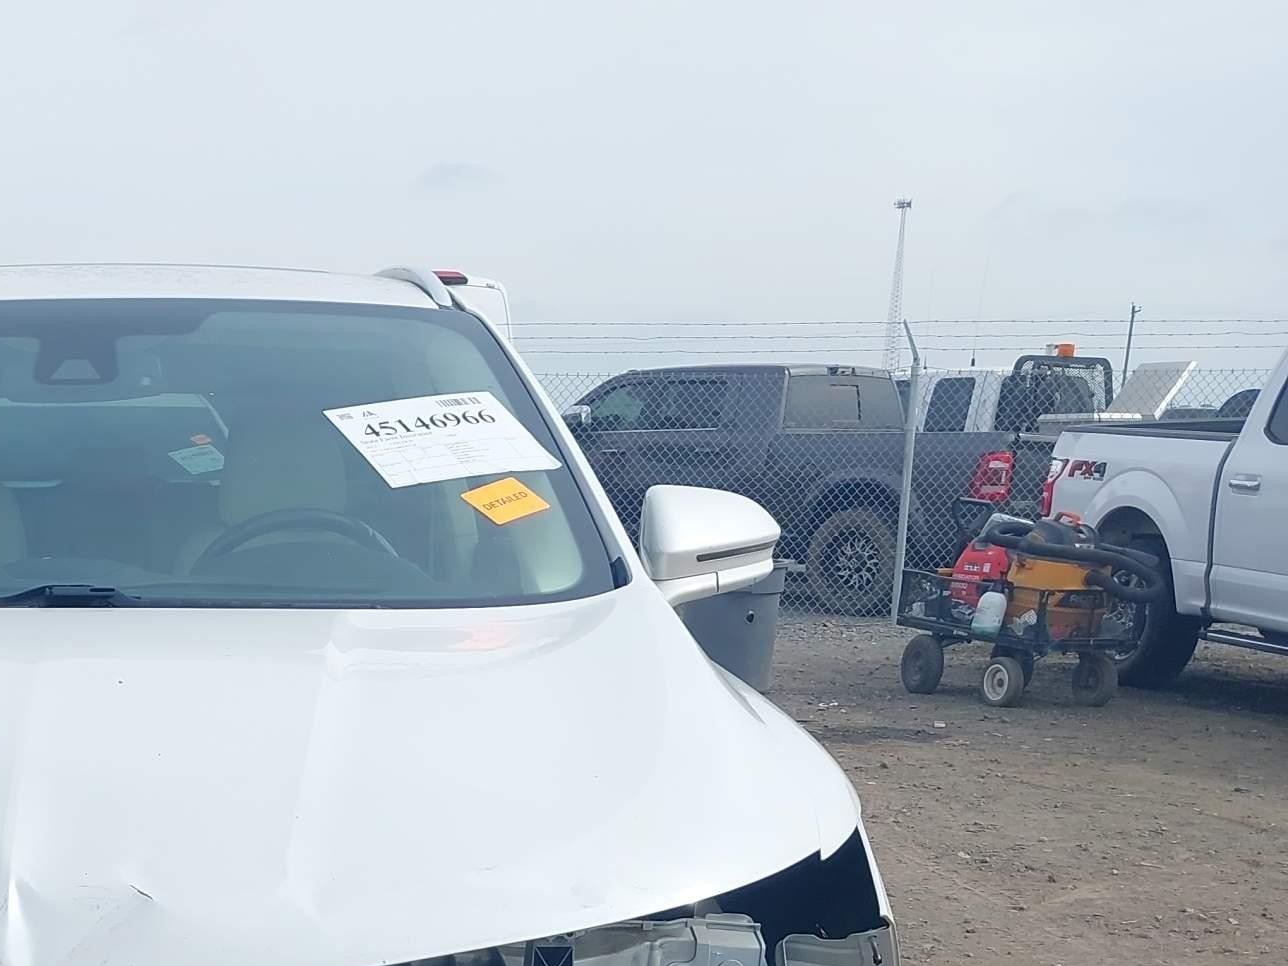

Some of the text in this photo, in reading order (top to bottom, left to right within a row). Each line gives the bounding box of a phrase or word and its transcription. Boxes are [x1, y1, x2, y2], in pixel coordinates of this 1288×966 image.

[364, 408, 496, 437] 45146966
[1068, 459, 1107, 477] FX4
[482, 491, 528, 511] DETAILED
